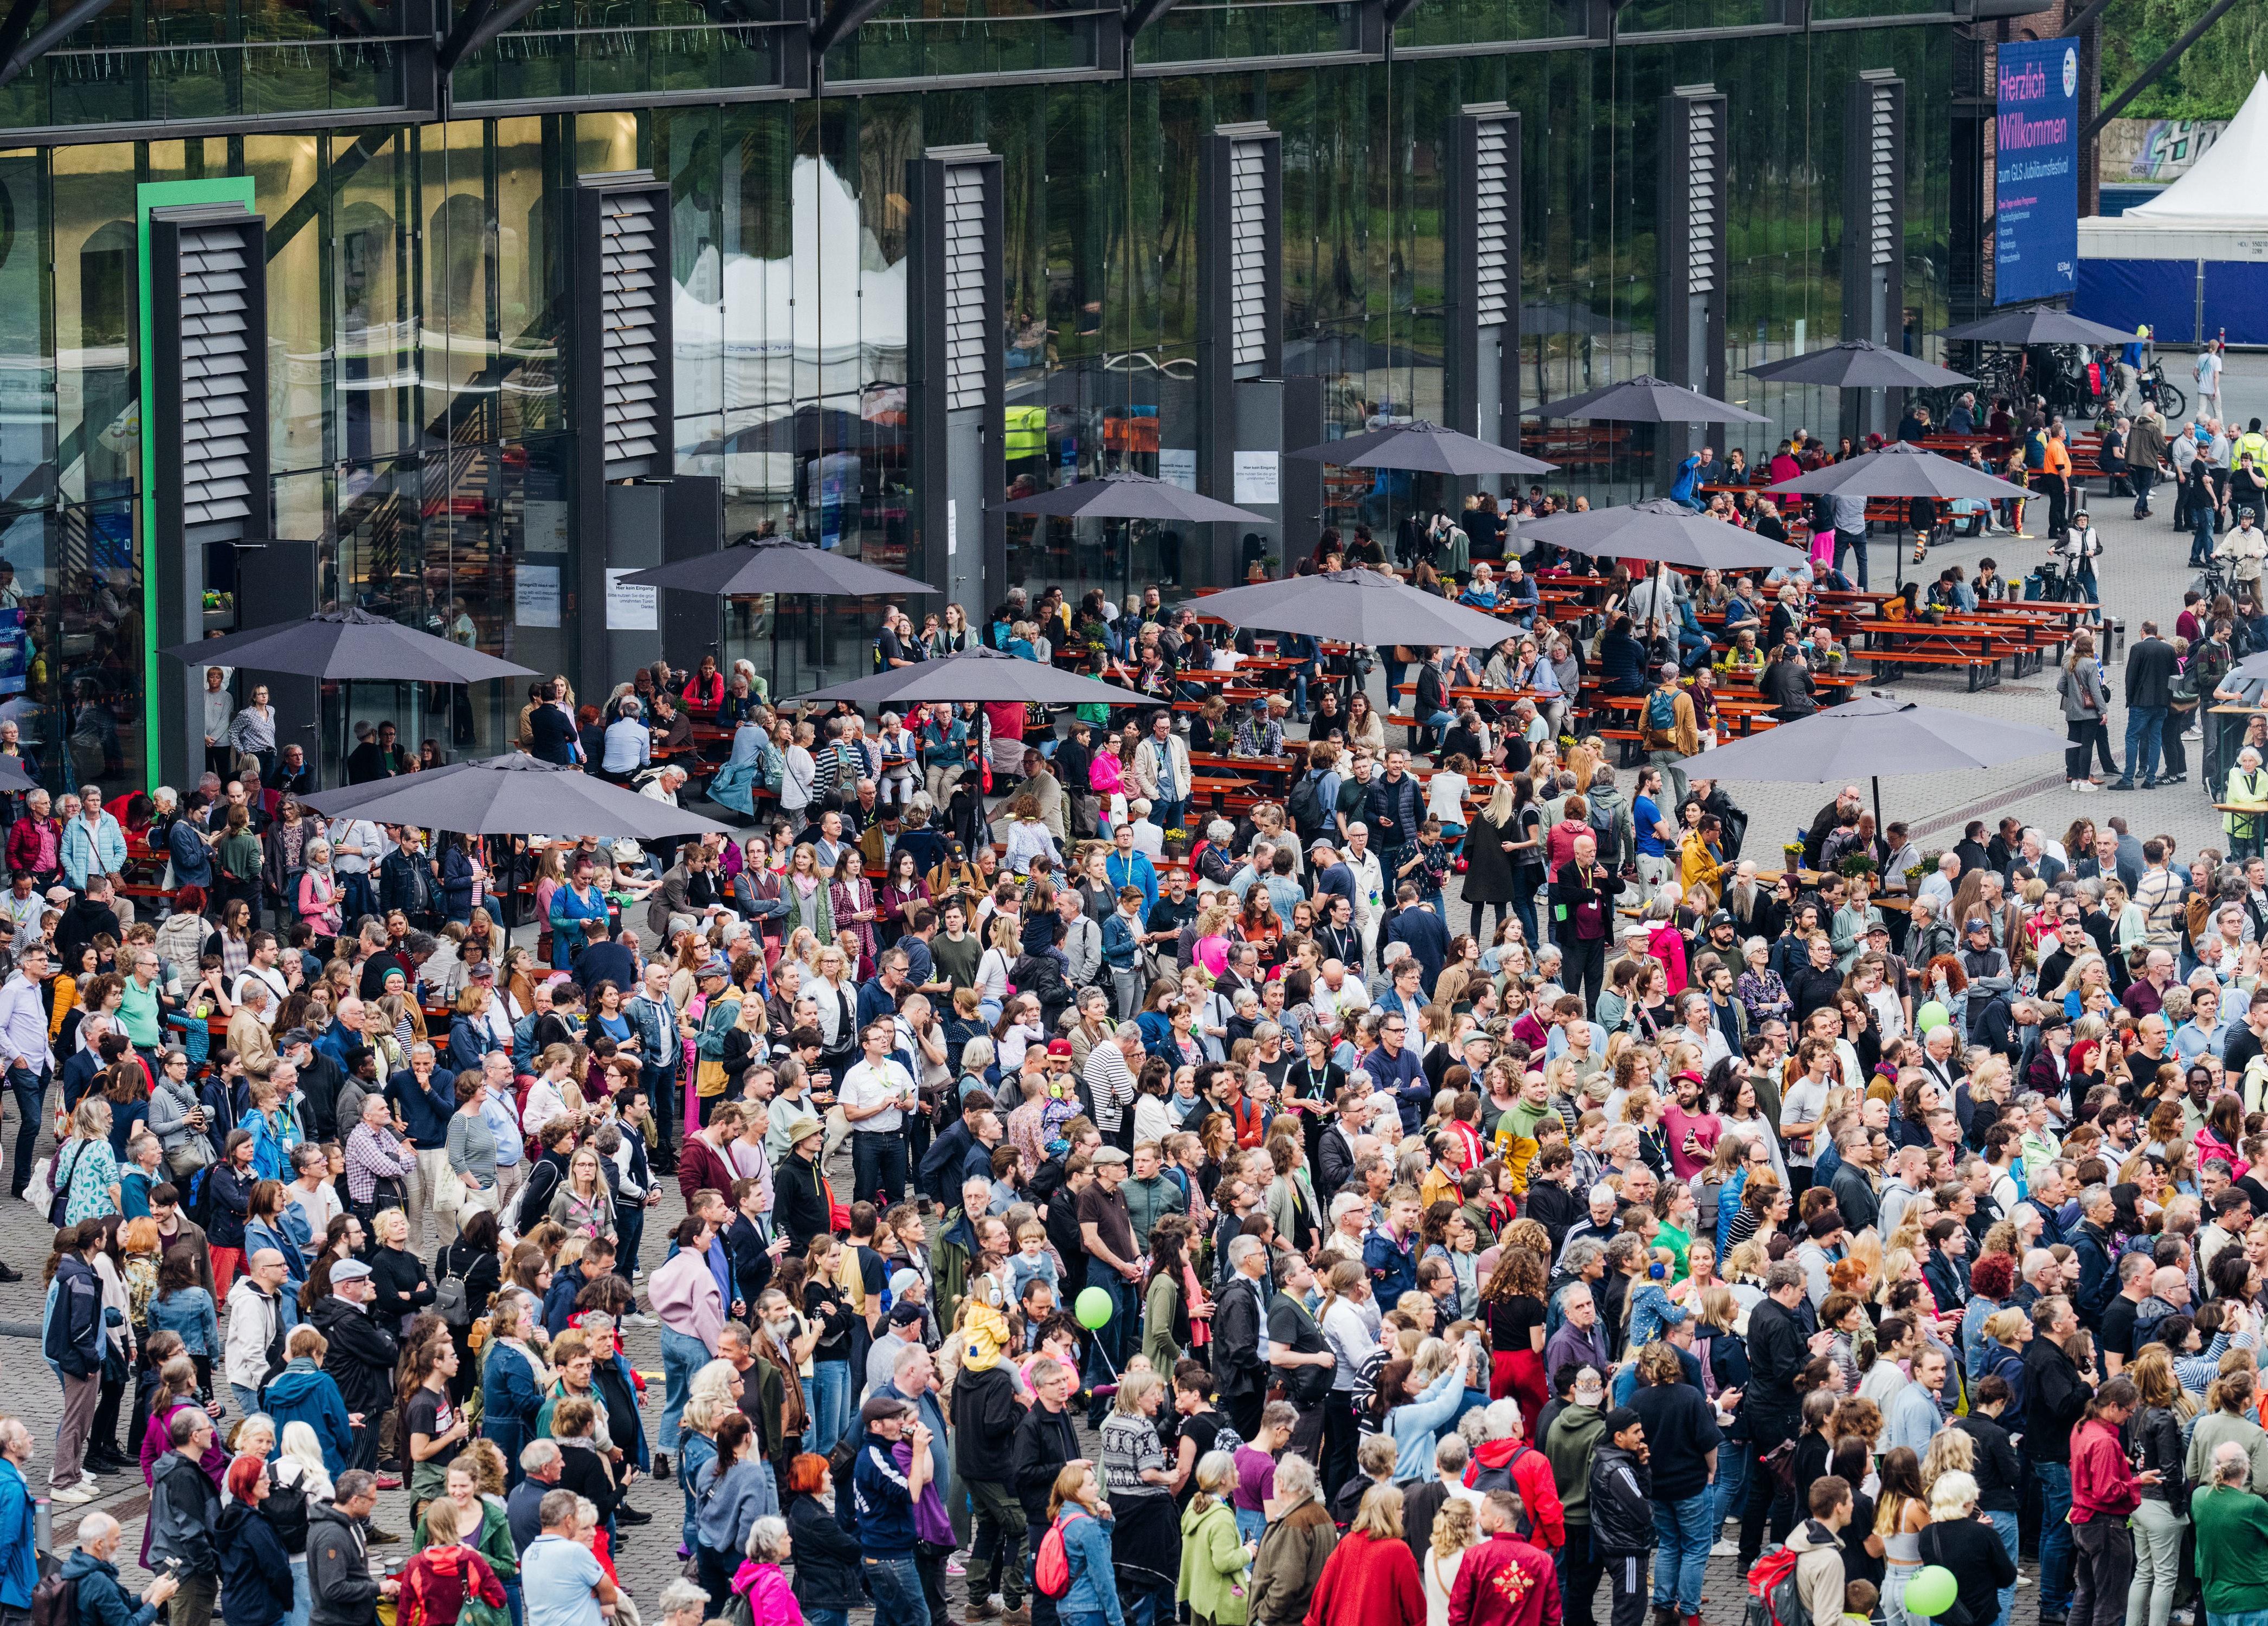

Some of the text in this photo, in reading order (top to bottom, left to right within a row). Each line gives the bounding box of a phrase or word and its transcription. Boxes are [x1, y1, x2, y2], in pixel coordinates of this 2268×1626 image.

[2000, 61, 2045, 101] Herzlich
[1998, 112, 2066, 150] Willkommen
[1999, 156, 2068, 183] zum GLS Jubiläumsfestival
[0, 626, 21, 634] achhaltige
